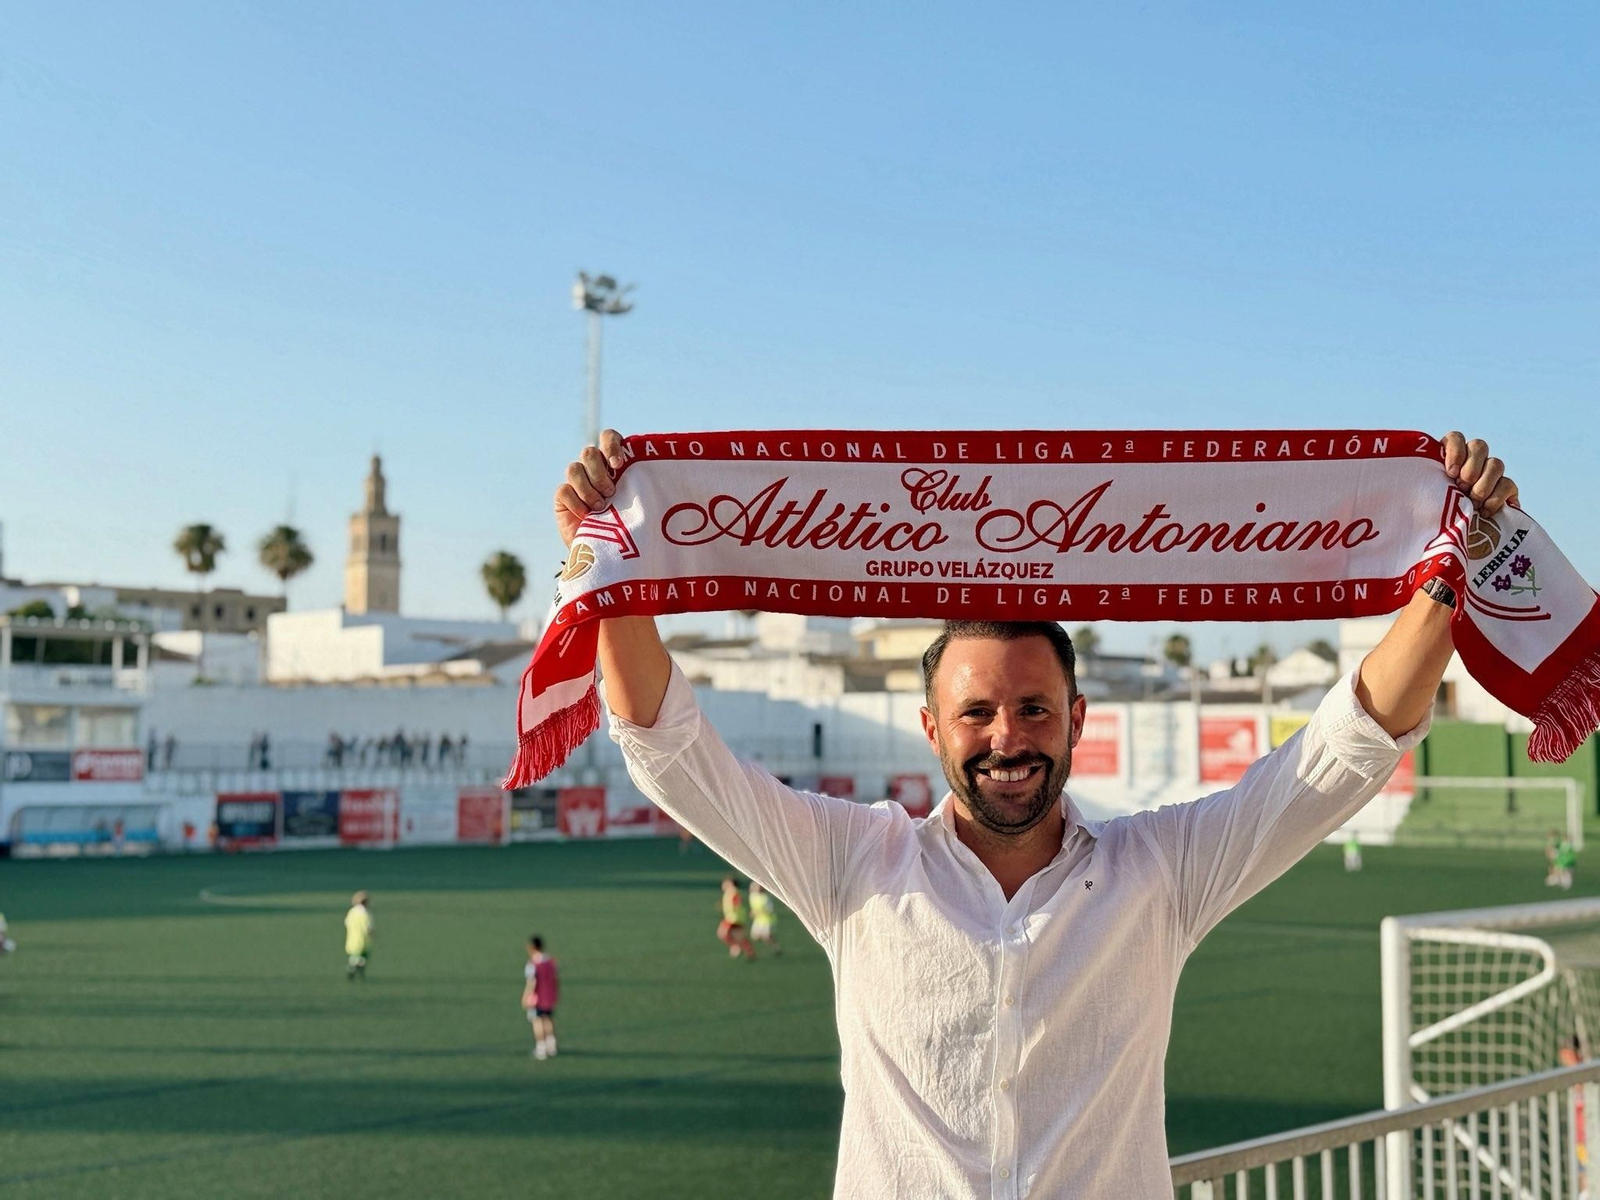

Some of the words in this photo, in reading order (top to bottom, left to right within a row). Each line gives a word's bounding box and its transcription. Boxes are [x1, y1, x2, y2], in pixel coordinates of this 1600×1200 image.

[731, 441, 907, 459] NACIONAL
[934, 442, 969, 459] DE
[996, 441, 1074, 460] LIGA
[1101, 439, 1135, 459] 2ª
[1162, 434, 1389, 458] FEDERACIÓN
[901, 467, 992, 515] Club
[661, 478, 948, 551] Atlético
[975, 479, 1379, 554] Antoniano
[866, 560, 934, 576] GRUPO
[937, 557, 1054, 580] VELÁZQUEZ
[1472, 528, 1530, 589] LEBRIJA
[745, 580, 911, 603] NACIONAL
[937, 587, 971, 604] DE
[997, 588, 1072, 605] LIGA
[1098, 587, 1134, 606] 2ª
[1157, 577, 1369, 605] FEDERACIÓN
